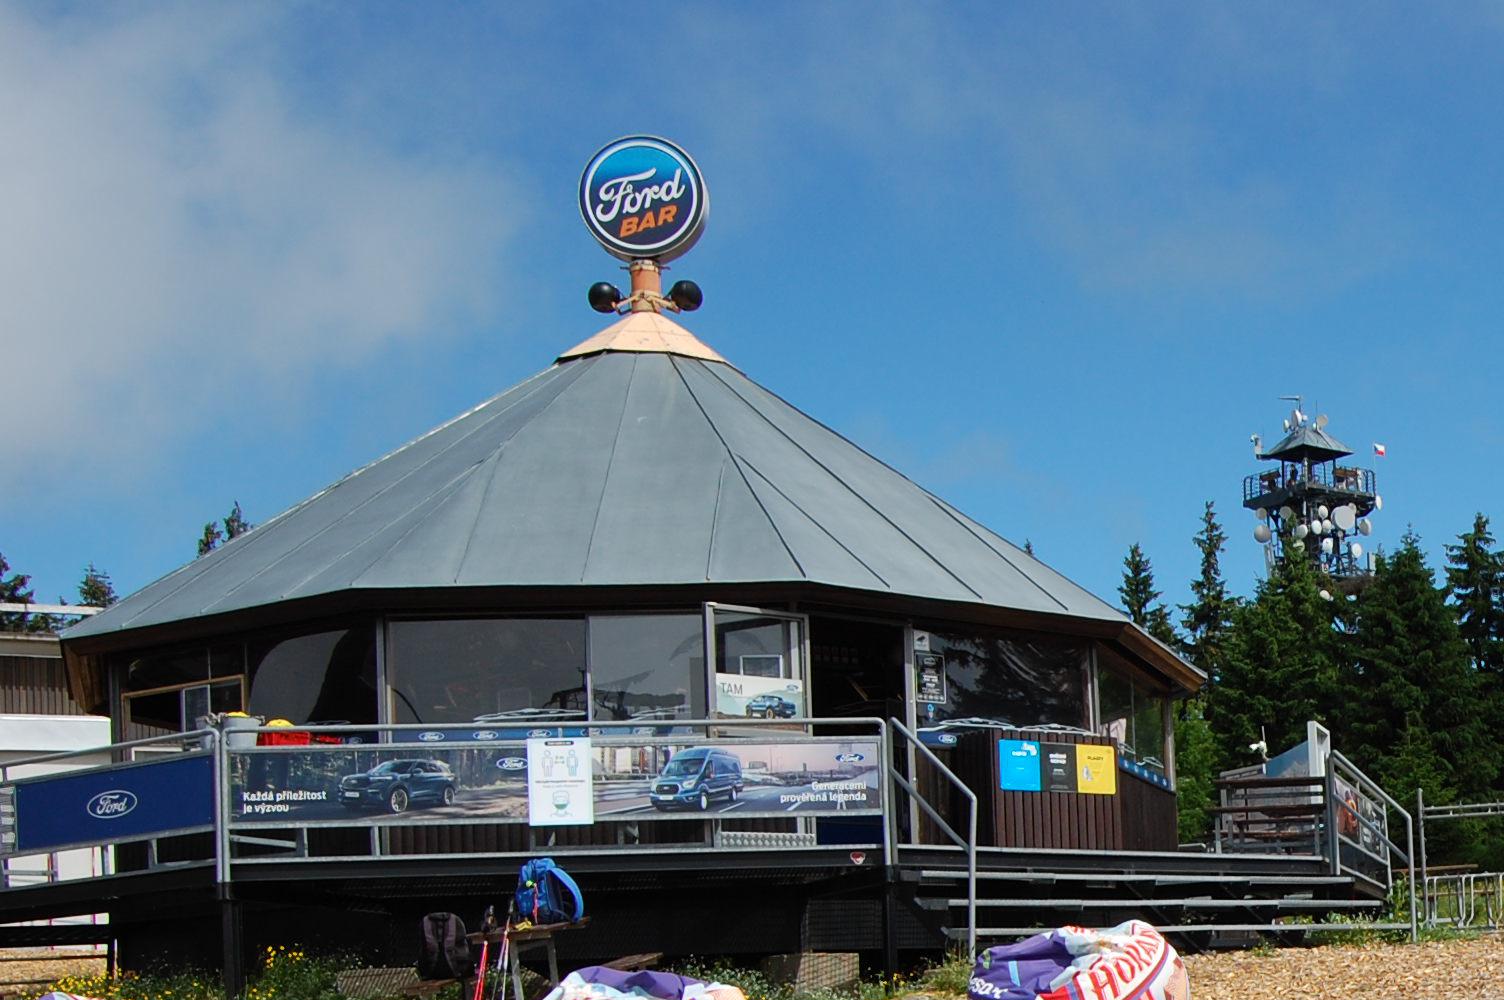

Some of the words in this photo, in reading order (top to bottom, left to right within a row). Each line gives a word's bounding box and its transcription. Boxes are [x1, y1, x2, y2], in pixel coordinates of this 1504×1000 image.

[596, 168, 685, 222] Ford
[620, 205, 677, 237] BAR
[719, 682, 743, 695] TAM
[97, 795, 128, 815] Ford
